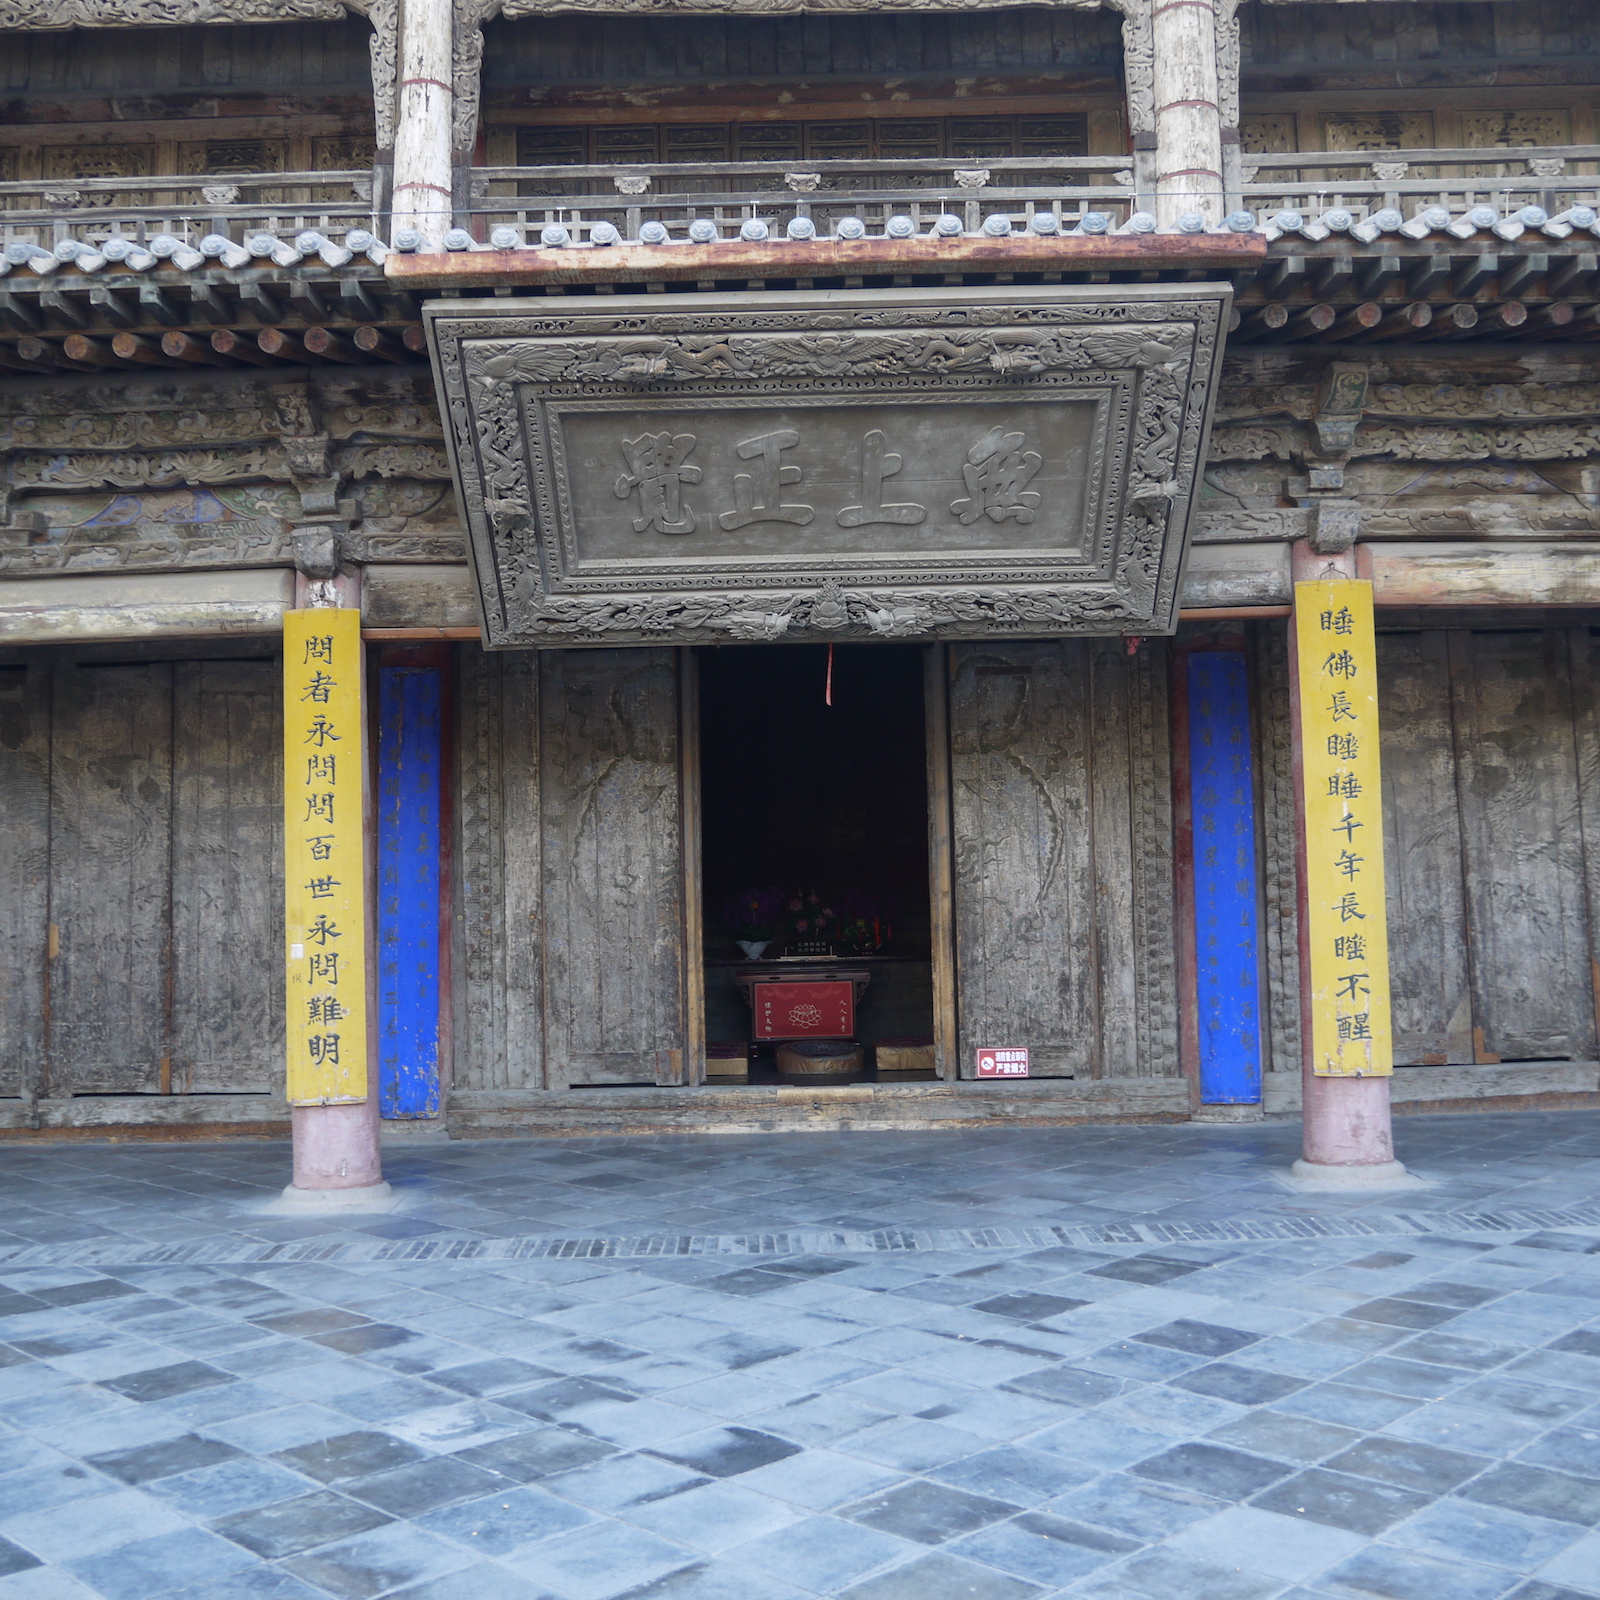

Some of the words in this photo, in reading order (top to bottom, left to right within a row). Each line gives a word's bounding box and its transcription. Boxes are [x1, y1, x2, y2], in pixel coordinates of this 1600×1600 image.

[300, 634, 344, 1066] 問者永問問百世永問難明
[995, 1063, 1026, 1074] 严禁烟火
